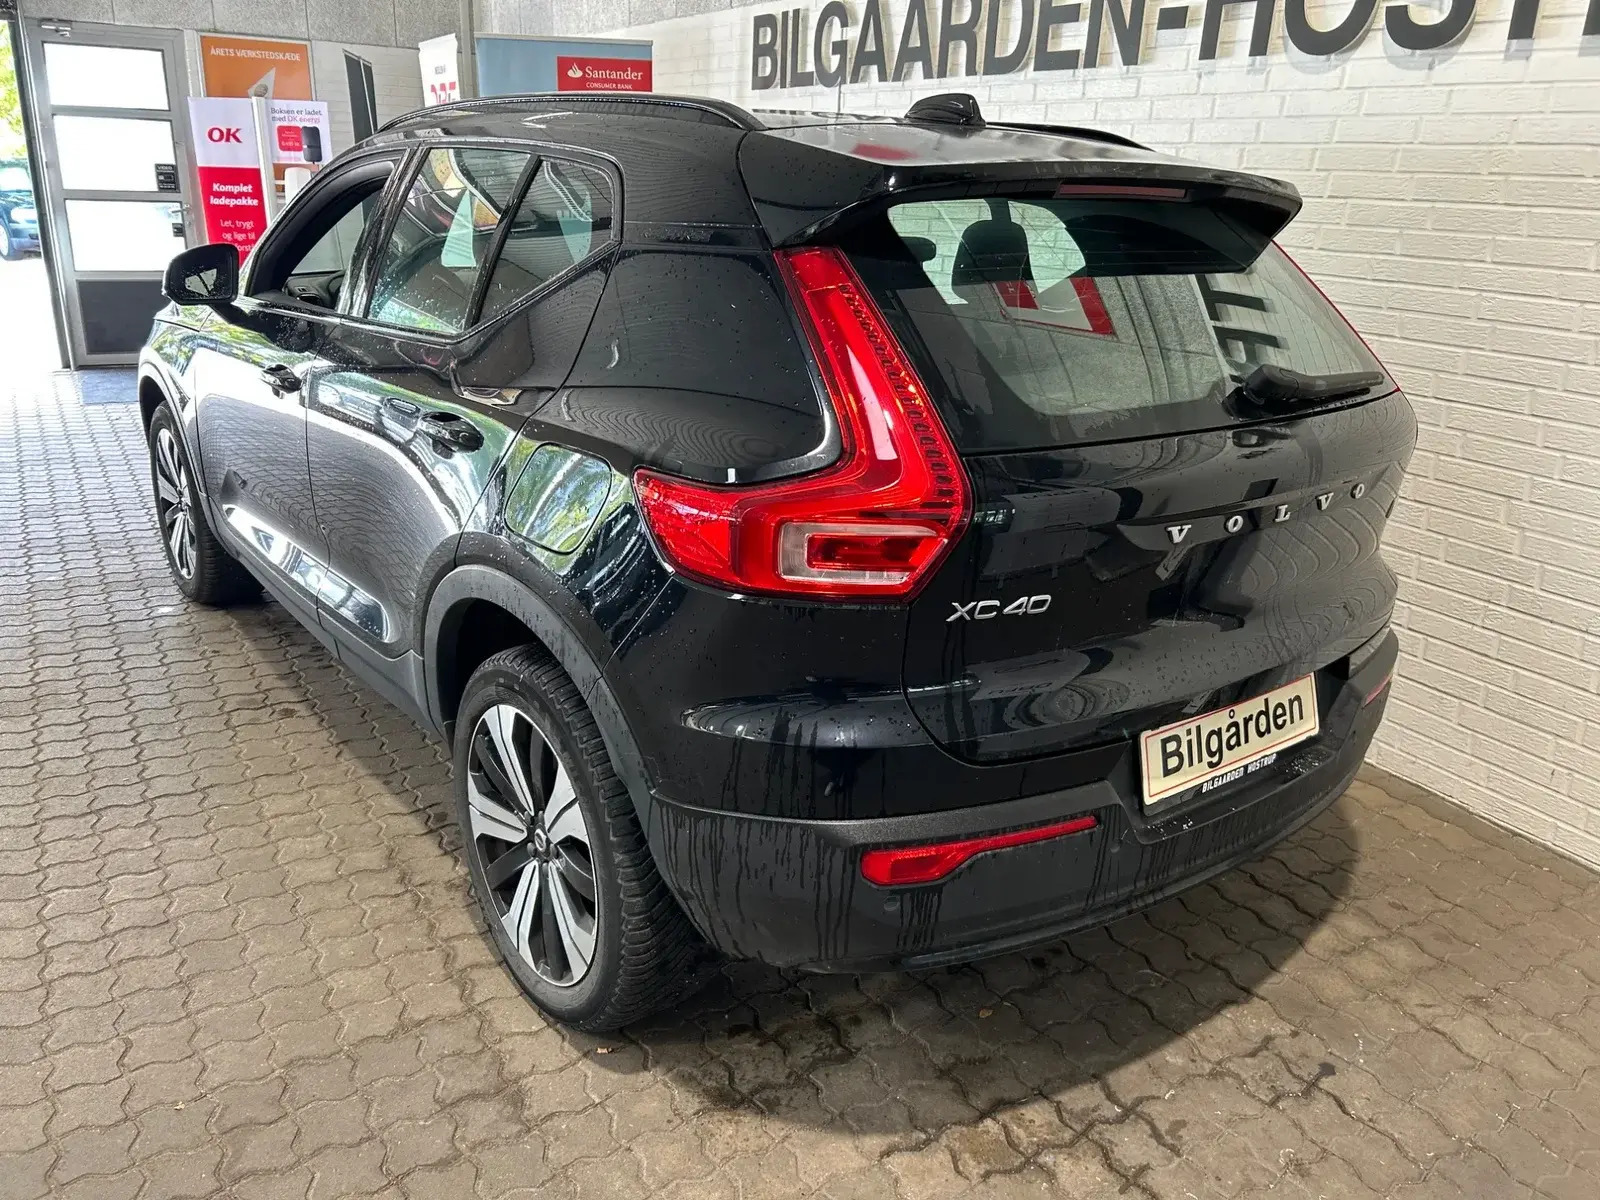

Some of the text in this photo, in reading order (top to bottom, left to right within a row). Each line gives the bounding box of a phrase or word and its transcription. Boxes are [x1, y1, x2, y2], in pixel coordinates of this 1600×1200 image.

[210, 45, 301, 62] ÅRETS VÆRKSTEDSKÆDE
[751, 0, 1600, 90] BILGAARDEN-H
[585, 64, 644, 81] Santander
[270, 107, 295, 115] Boksen
[207, 126, 242, 144] OK
[212, 182, 253, 194] Komplet
[209, 195, 259, 208] ladepakke
[235, 220, 254, 230] trygt
[222, 231, 256, 242] og lige til
[1166, 481, 1366, 545] VOLVO
[945, 593, 1052, 622] XC40
[1160, 692, 1304, 778] Bilgården
[1201, 752, 1277, 794] BILGAARDEN HOSTRUP
